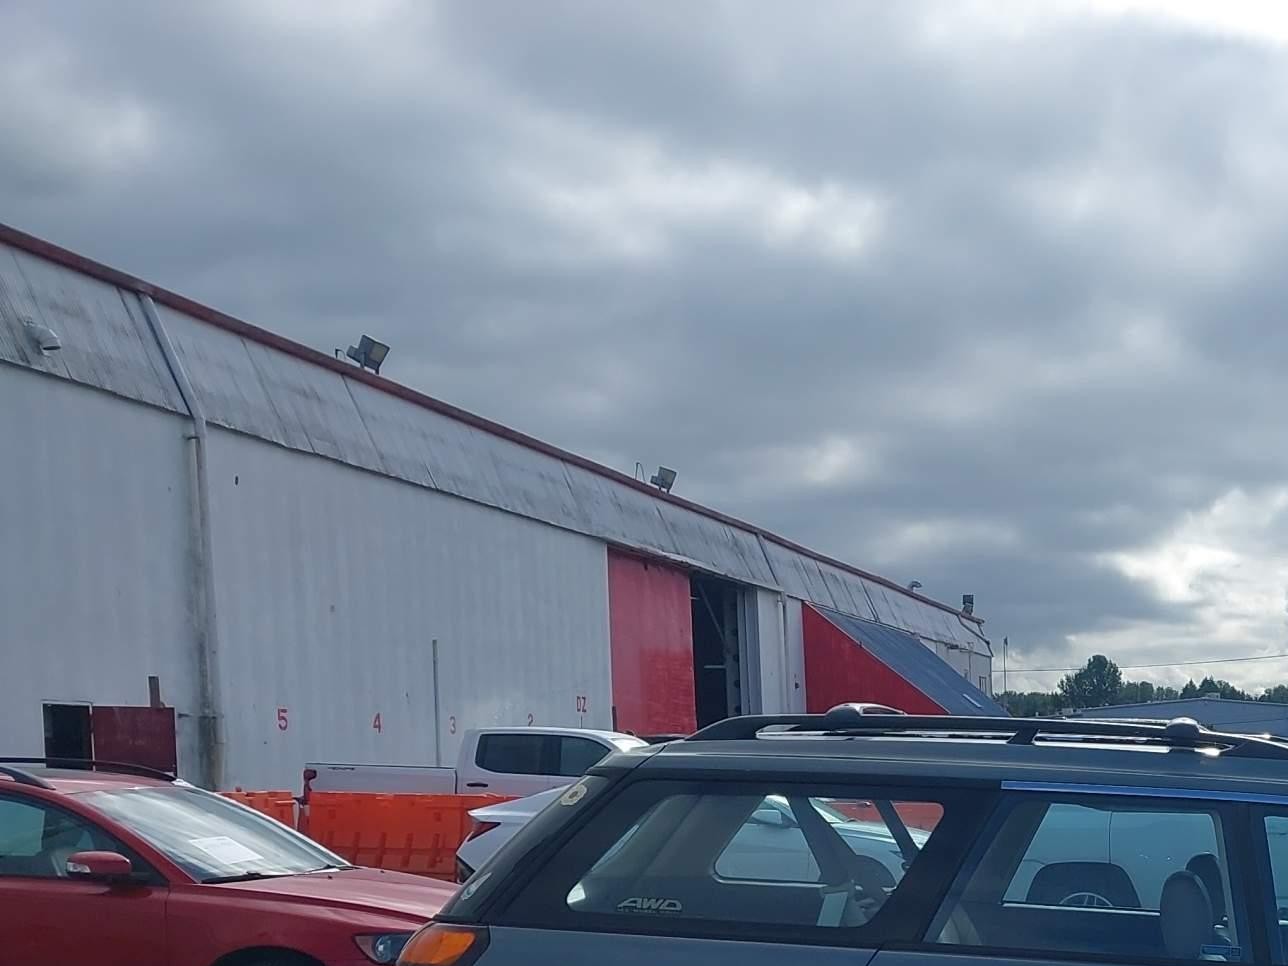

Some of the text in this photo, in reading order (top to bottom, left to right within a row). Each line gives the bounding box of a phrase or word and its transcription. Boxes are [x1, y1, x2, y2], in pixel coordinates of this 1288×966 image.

[277, 708, 288, 731] 5
[372, 712, 382, 734] 4
[449, 715, 457, 735] 3
[617, 897, 682, 911] AWD
